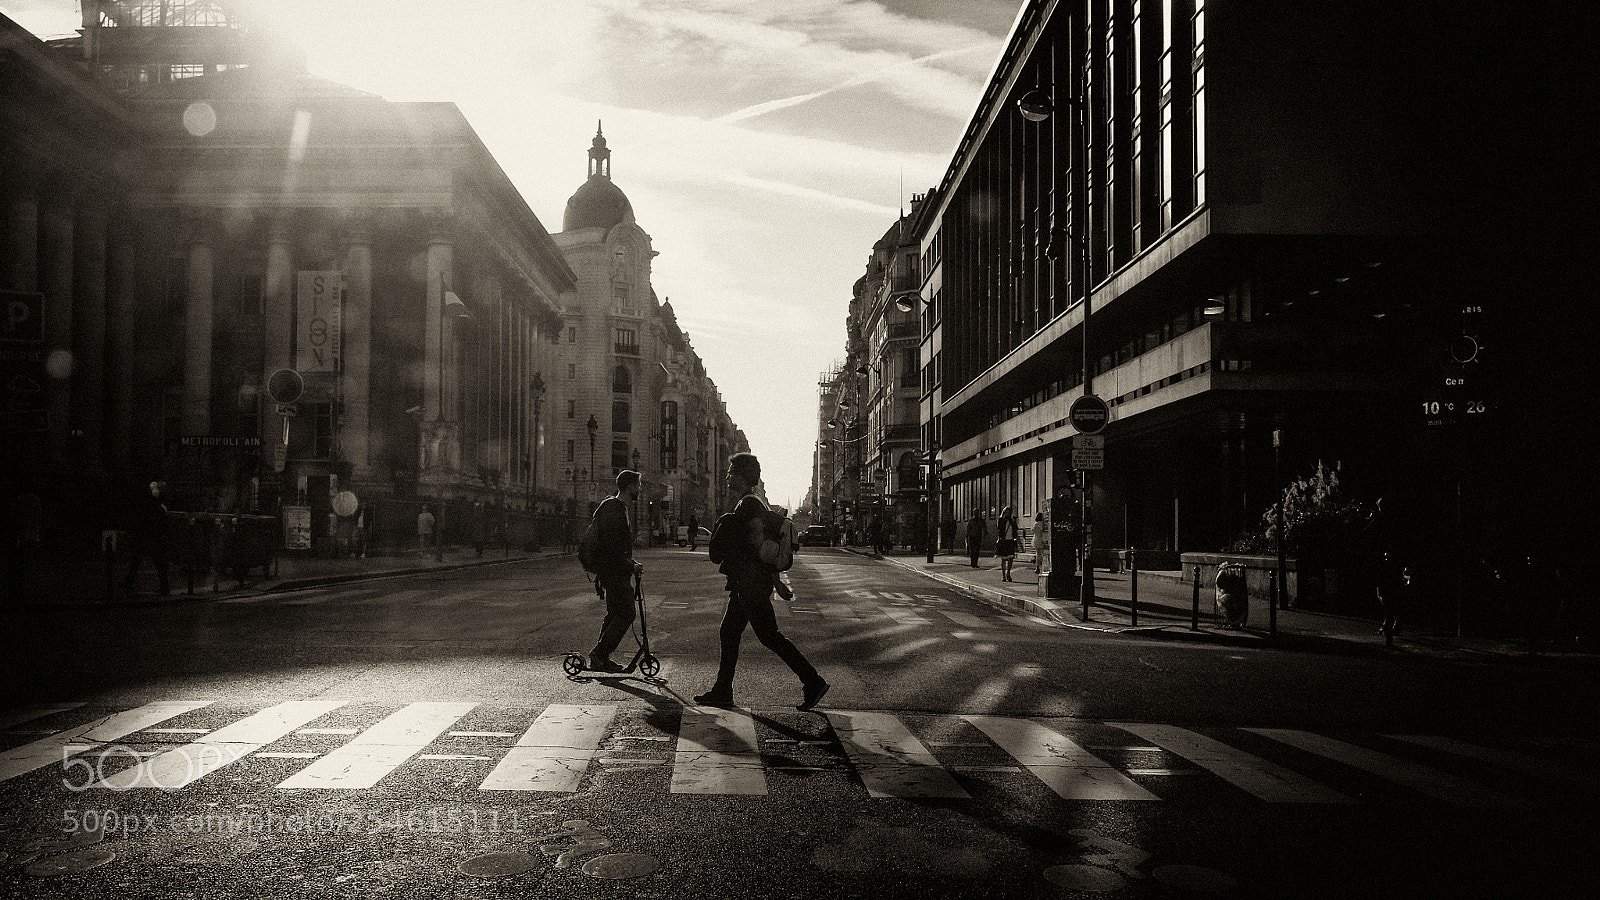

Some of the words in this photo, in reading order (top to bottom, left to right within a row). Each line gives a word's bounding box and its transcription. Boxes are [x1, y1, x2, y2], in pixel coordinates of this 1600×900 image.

[8, 301, 30, 331] P
[1422, 401, 1440, 415] 10
[1466, 400, 1486, 414] 26
[181, 437, 261, 446] METROPOLIAIN
